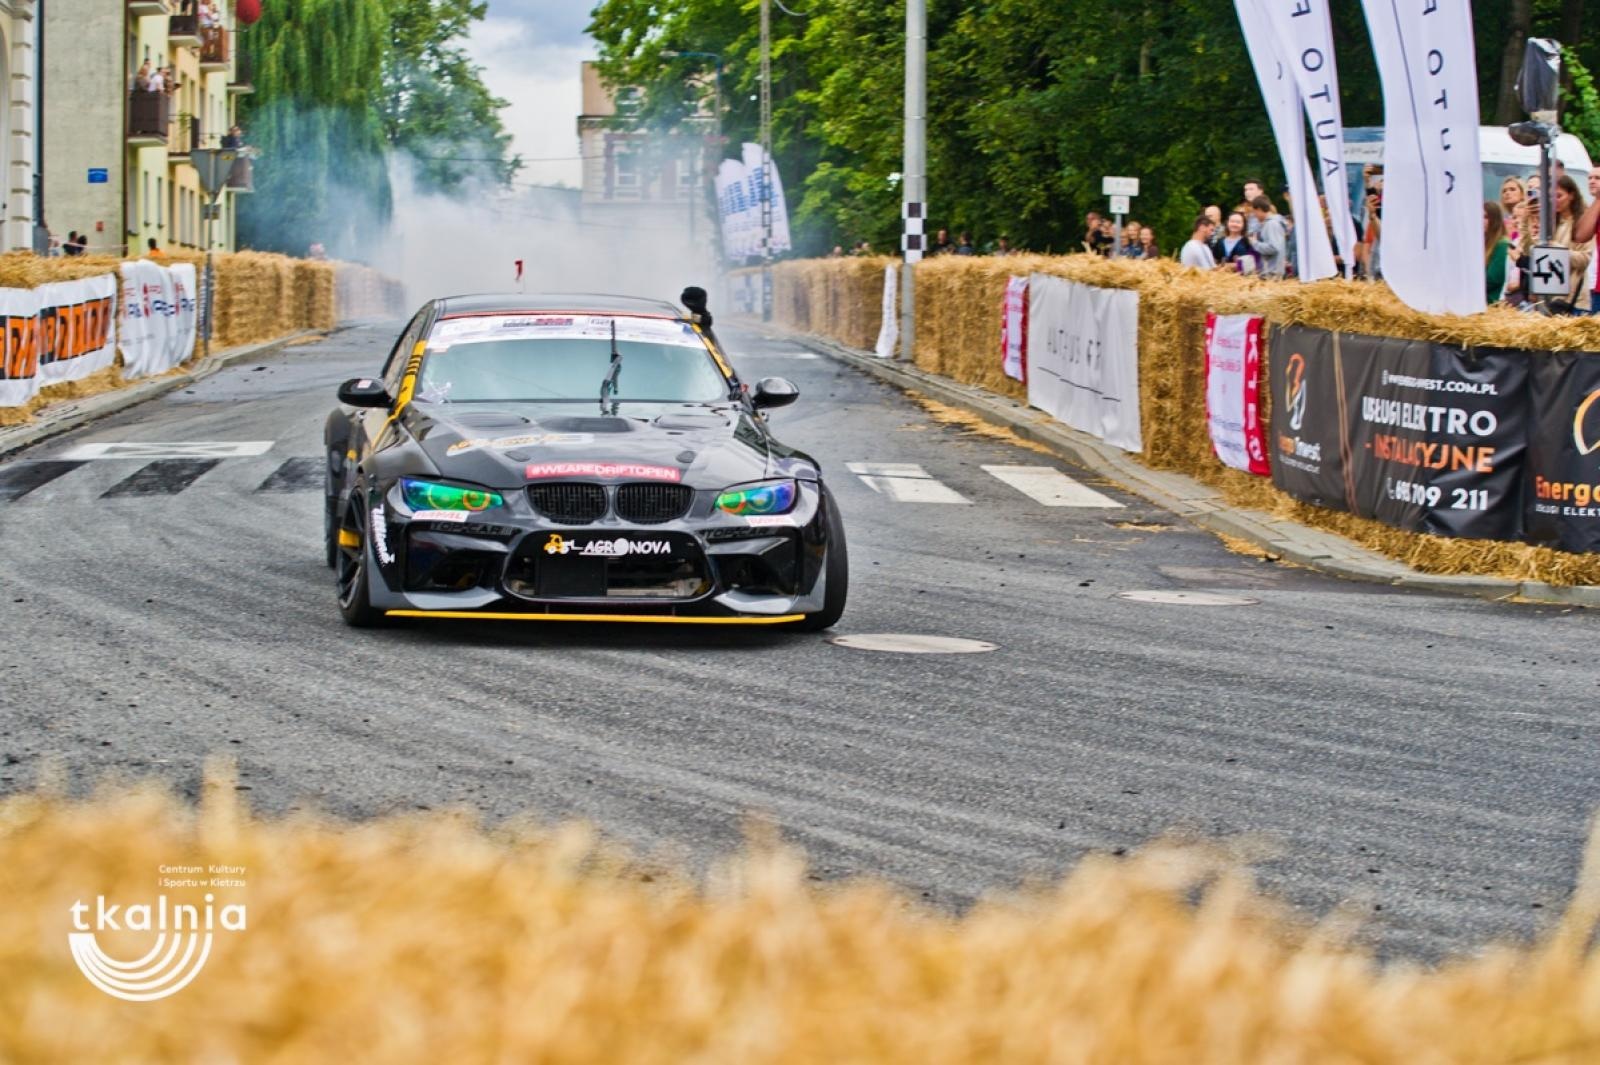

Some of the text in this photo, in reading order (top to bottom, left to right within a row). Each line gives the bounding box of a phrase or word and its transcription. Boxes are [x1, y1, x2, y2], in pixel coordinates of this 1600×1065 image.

[1402, 402, 1498, 437] ELEKTRO
[531, 464, 676, 479] #WEAREDRIFTOPEN
[1451, 487, 1489, 511] 211
[584, 537, 672, 556] AGRONOVA
